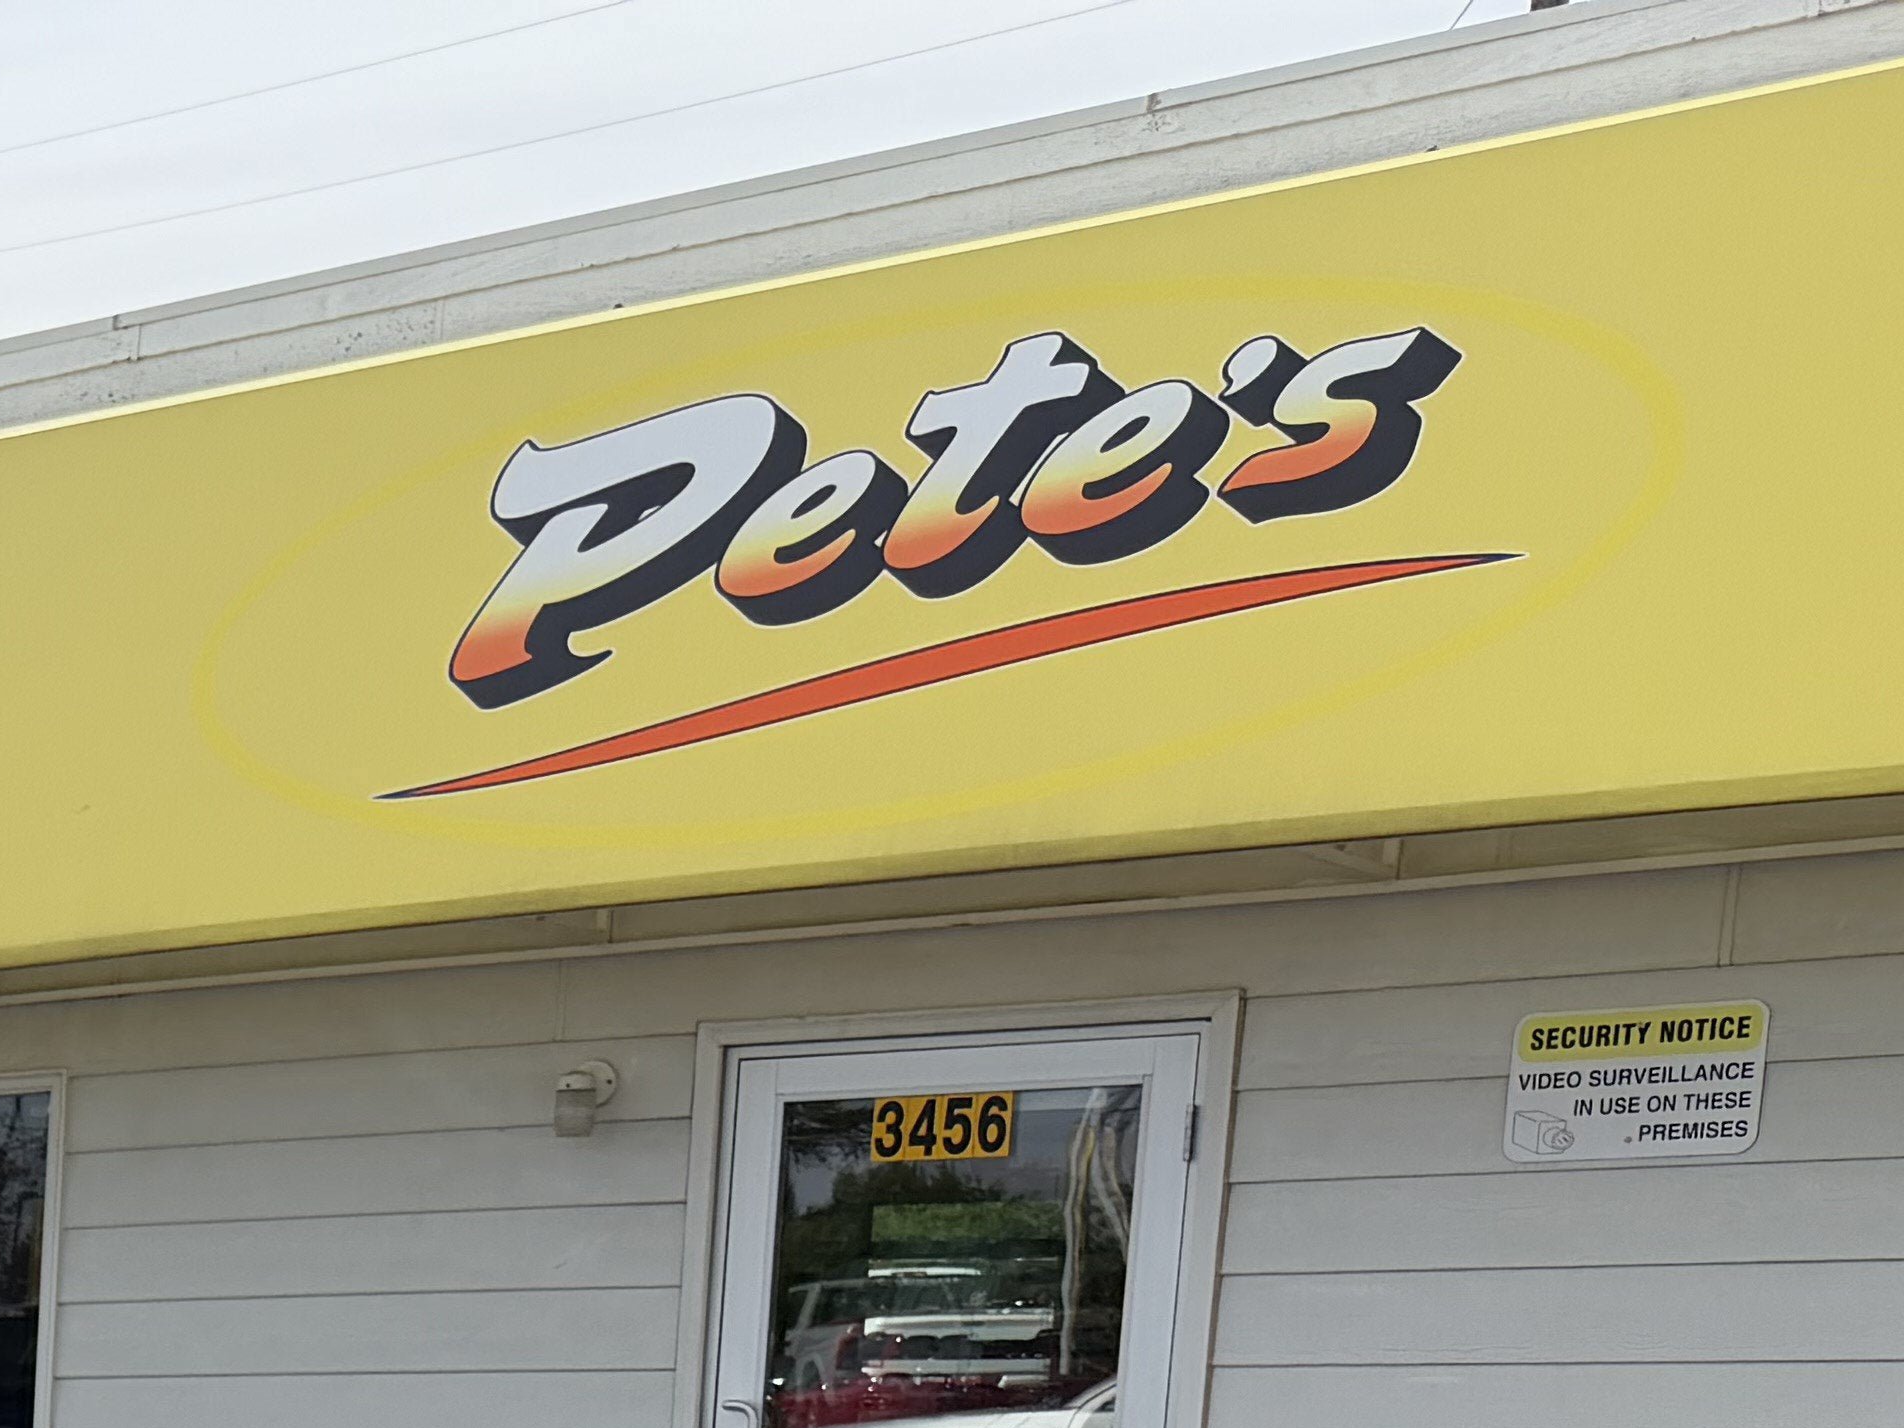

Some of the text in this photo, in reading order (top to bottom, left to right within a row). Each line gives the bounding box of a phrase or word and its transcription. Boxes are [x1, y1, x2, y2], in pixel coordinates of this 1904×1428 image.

[448, 327, 1462, 709] Pete's
[1530, 1015, 1753, 1051] SECURITY NOTICE
[1519, 1061, 1756, 1091] VIDEO SURVEILLANCE
[1573, 1090, 1752, 1118] IN USE ON THESE
[874, 1095, 1008, 1157] 3456
[1638, 1120, 1749, 1143] PREMISES
